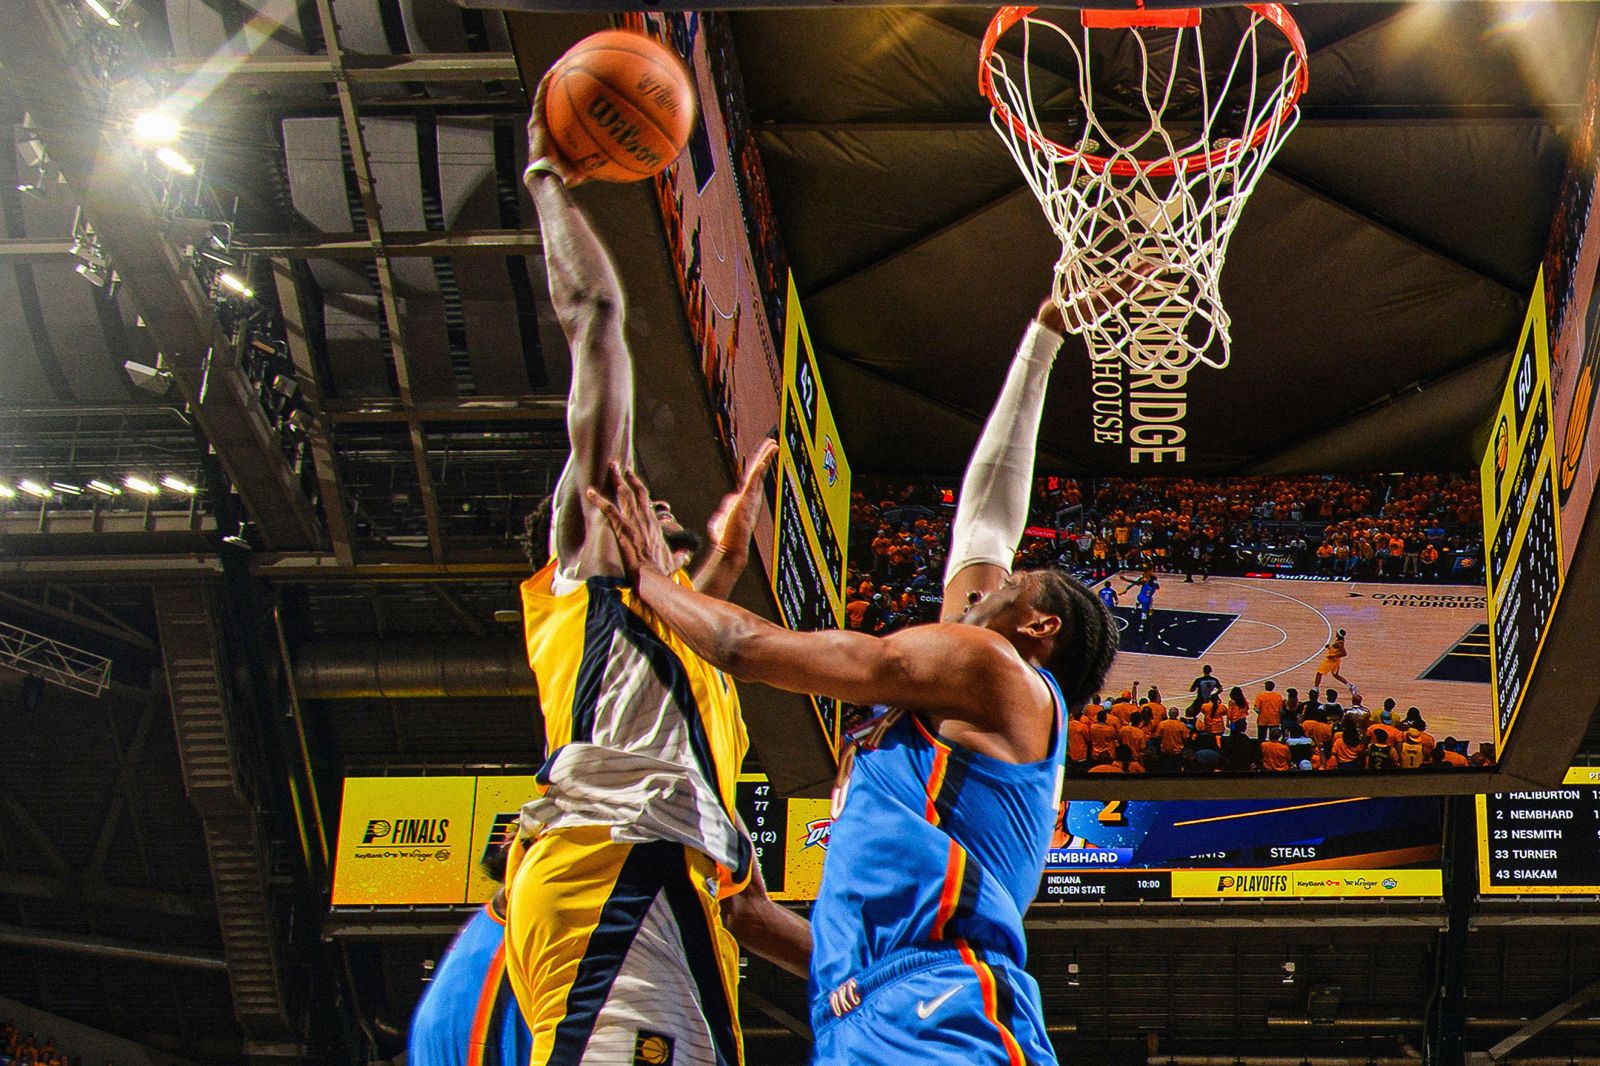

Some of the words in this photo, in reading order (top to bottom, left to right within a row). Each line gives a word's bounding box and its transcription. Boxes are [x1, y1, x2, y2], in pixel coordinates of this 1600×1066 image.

[1518, 353, 1531, 411] 60
[800, 362, 812, 420] 42
[1275, 573, 1331, 581] YouTube
[754, 786, 770, 796] 47
[1509, 790, 1580, 800] HALIBURTON
[754, 801, 769, 811] 77
[1496, 811, 1503, 819] 2
[1510, 810, 1574, 819] NEMBHARD
[757, 816, 765, 826] 9
[391, 818, 449, 843] FINALS
[1494, 830, 1508, 839] 23
[1511, 830, 1562, 839] NESMITH
[760, 831, 777, 843] (2)
[1270, 847, 1316, 858] STEALS
[1495, 850, 1509, 859] 33
[1512, 850, 1557, 859] TURNER
[1045, 853, 1118, 863] NEMBHARD
[1496, 870, 1510, 879] 43
[1513, 870, 1557, 879] SIAKAM
[1048, 876, 1081, 884] INDIANA
[1137, 880, 1160, 888] 10:00
[1236, 875, 1288, 892] PLAYOFFS
[1354, 877, 1378, 890] Kroger
[1048, 886, 1080, 894] GOLDEN
[1081, 886, 1106, 894] STATE
[830, 977, 861, 1018] OKC
